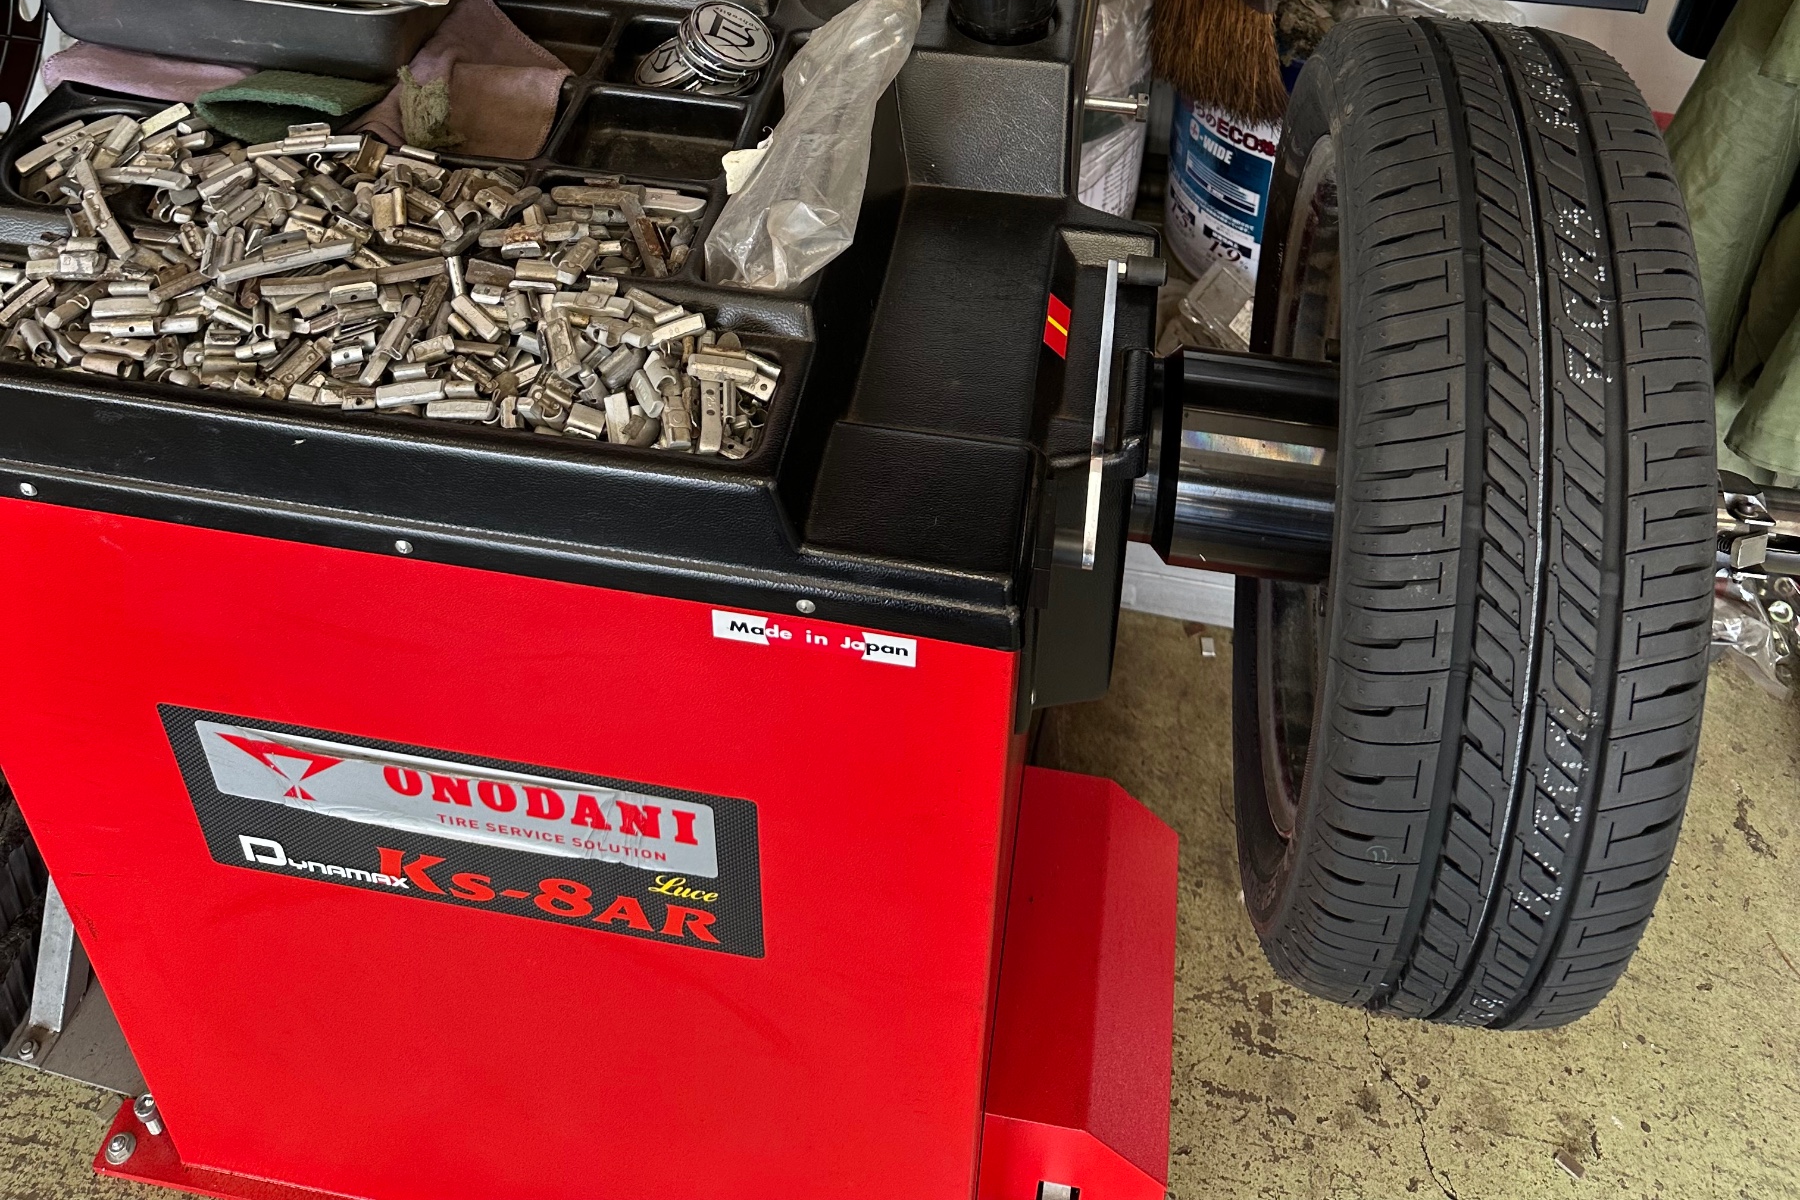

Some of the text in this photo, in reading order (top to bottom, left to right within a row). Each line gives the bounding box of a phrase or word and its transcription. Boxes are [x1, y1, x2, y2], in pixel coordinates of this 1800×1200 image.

[729, 620, 909, 657] Made in Japan
[384, 766, 699, 846] ONODANI
[436, 813, 668, 862] TIRE SERVICE SOLUTION
[647, 873, 719, 904] Luce
